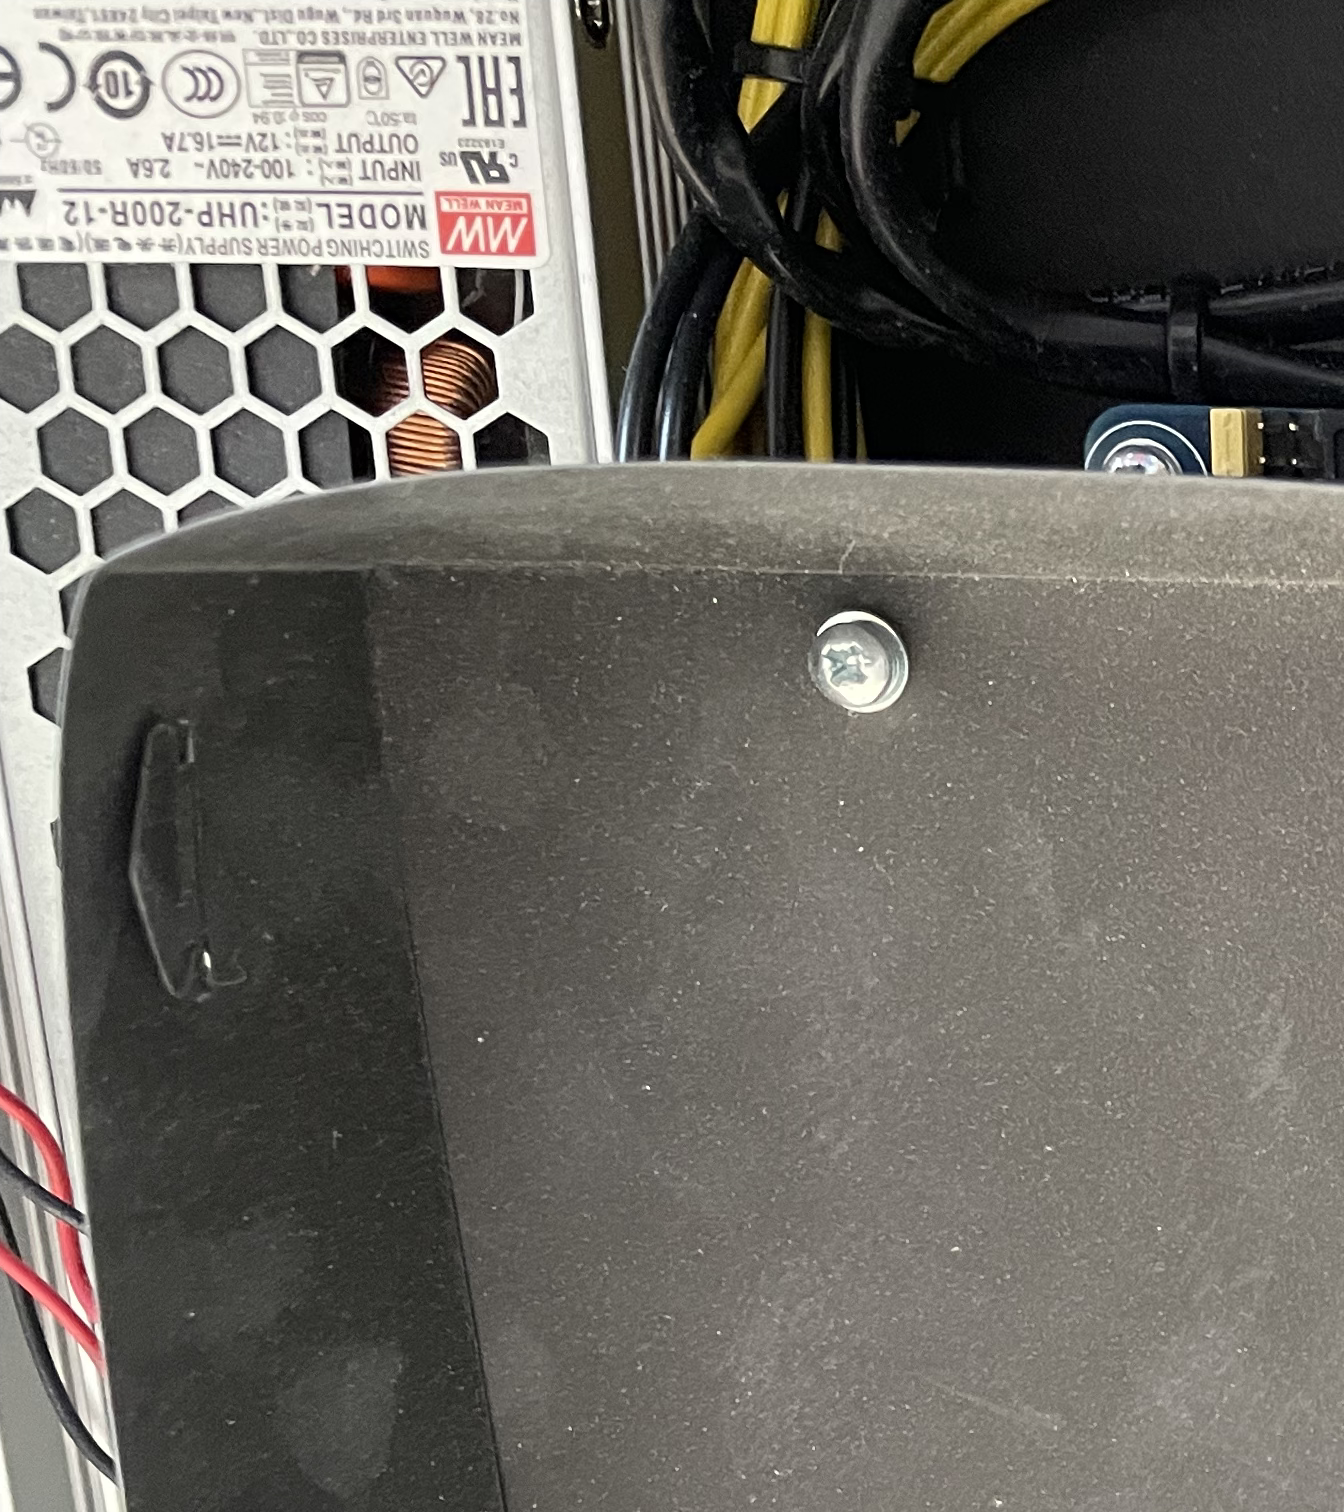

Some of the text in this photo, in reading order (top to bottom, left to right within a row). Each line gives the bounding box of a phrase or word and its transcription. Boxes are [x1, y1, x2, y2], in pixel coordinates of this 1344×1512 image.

[322, 31, 427, 46] ENTERPRISES
[430, 31, 475, 46] WELL
[478, 32, 522, 46] MEAN
[335, 133, 419, 153] OUTPUT
[358, 158, 421, 181] INPUT
[445, 198, 524, 212] MEAN WELL
[315, 202, 427, 230] MODEL
[446, 215, 528, 253] MW
[256, 237, 322, 258] POWER
[327, 239, 430, 259] SWITCHING
